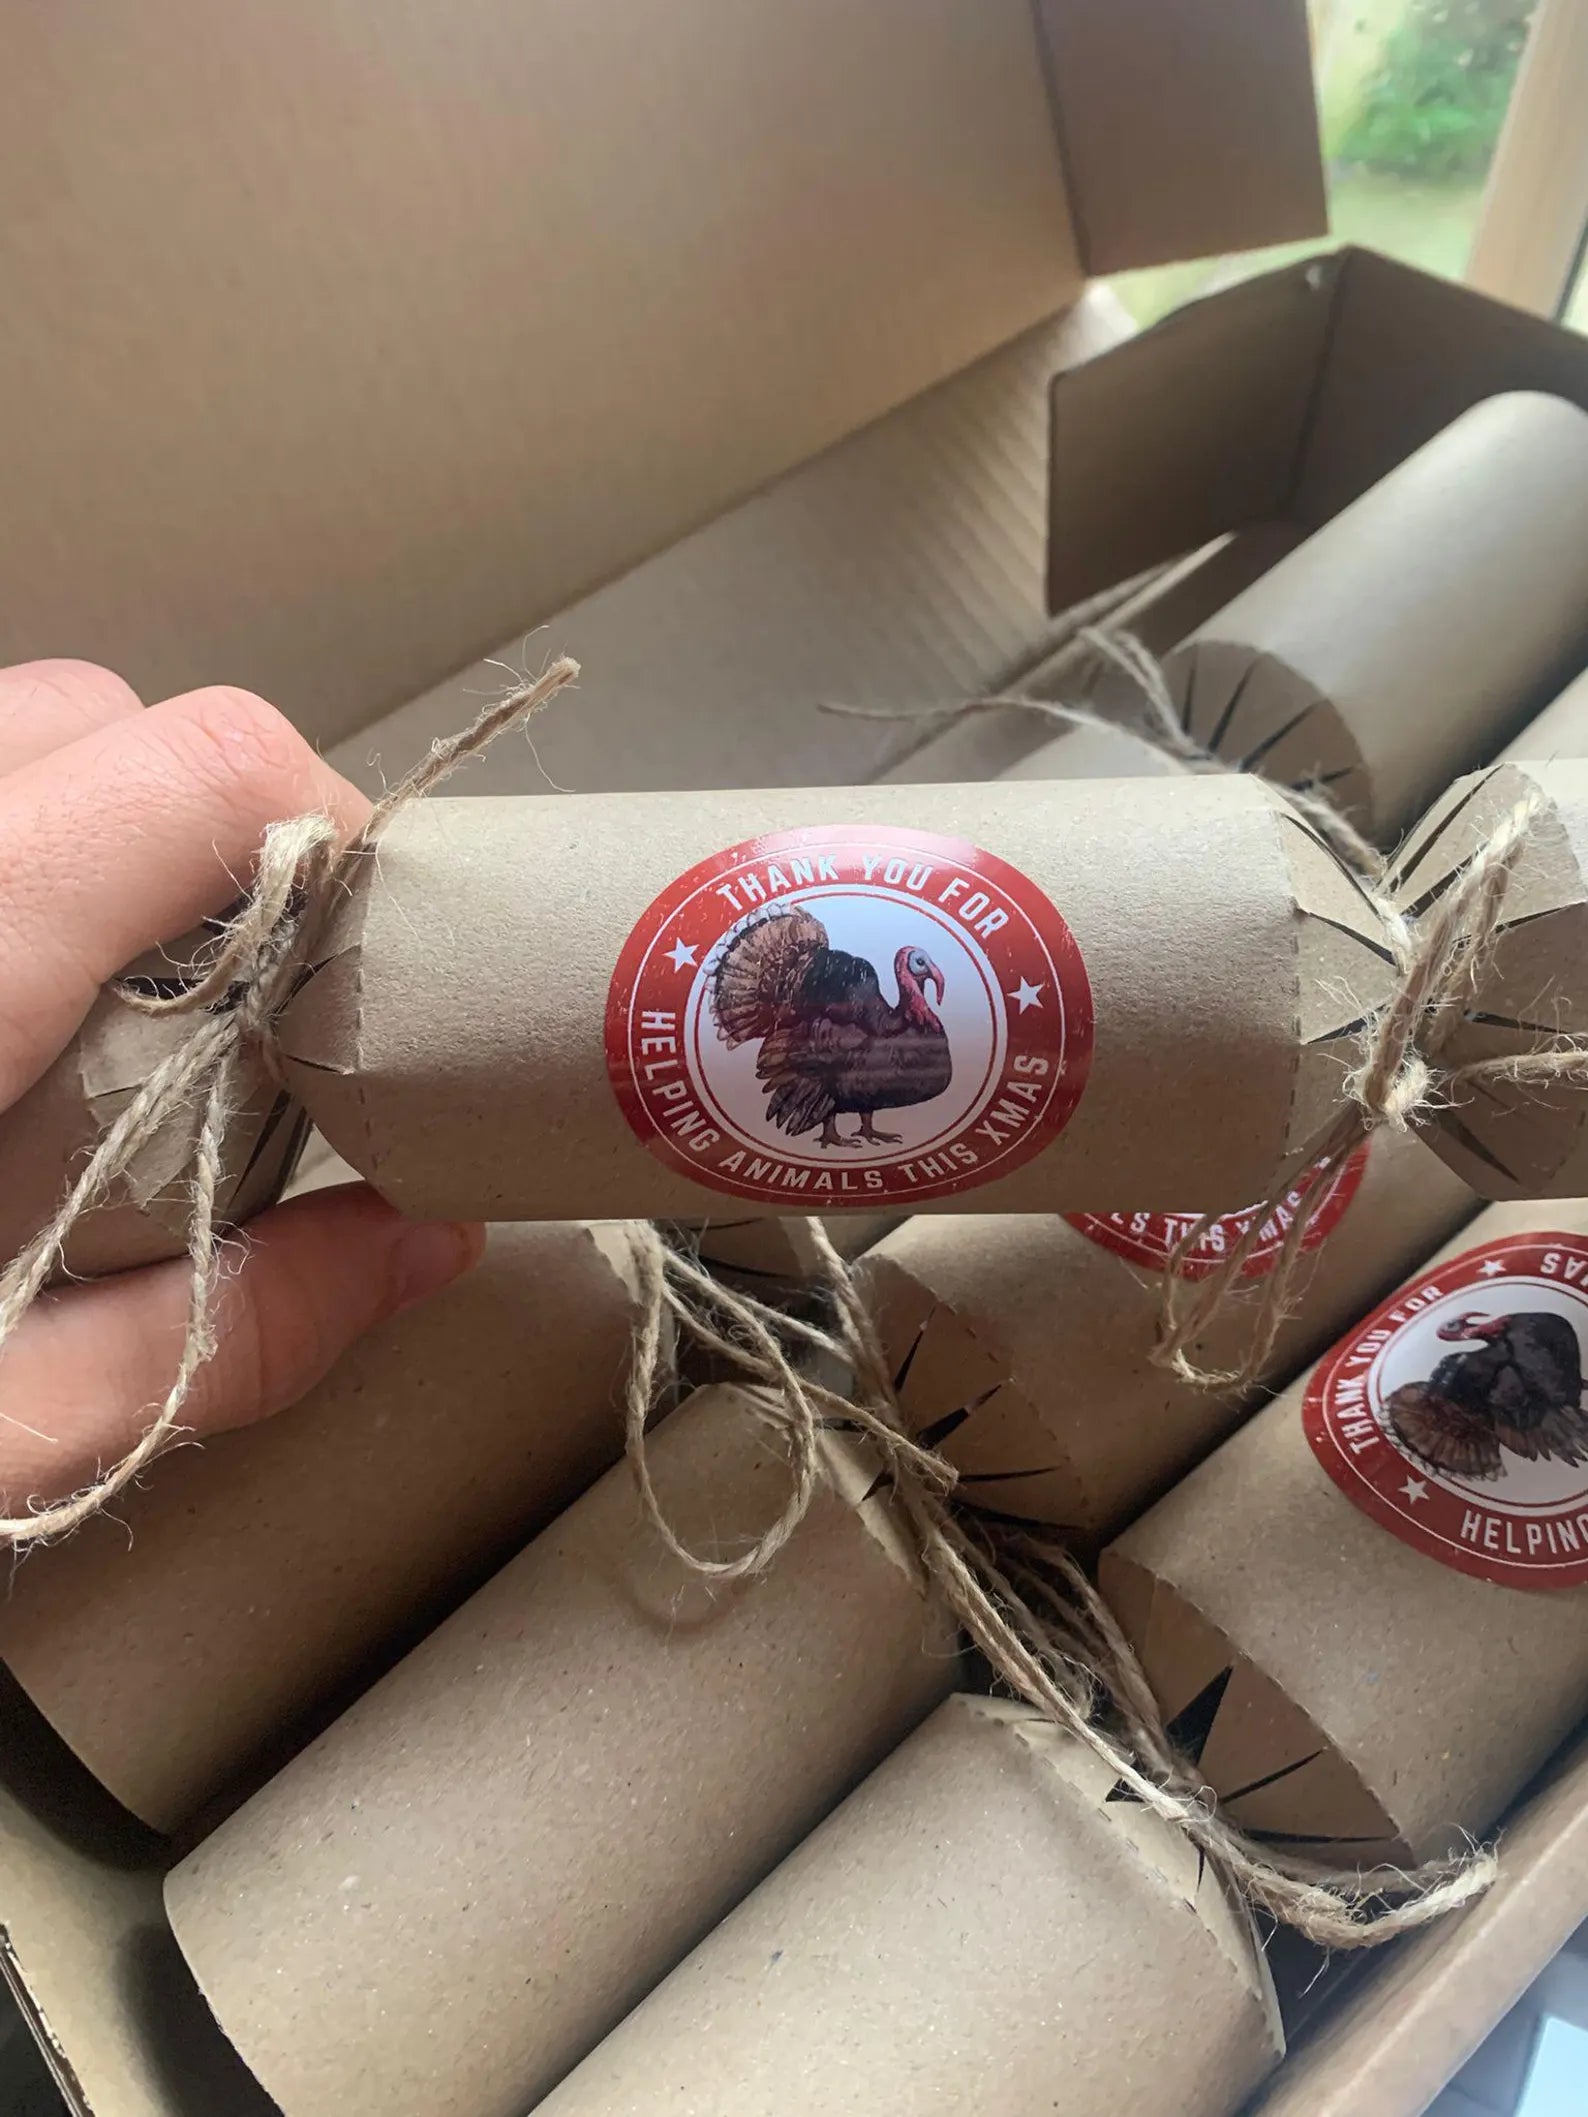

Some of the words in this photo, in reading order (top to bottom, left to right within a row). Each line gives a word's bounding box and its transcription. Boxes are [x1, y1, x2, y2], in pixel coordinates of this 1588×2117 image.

[715, 853, 839, 912] THANK
[862, 855, 933, 892] YOU
[938, 877, 1009, 940] FOR
[640, 1010, 721, 1152] HELPING
[718, 1150, 883, 1191] ANIMALS
[897, 1143, 979, 1183] THIS
[975, 1055, 1049, 1146] XMAS
[1388, 1285, 1444, 1322] FOR
[1345, 1329, 1392, 1367] YOU
[1335, 1374, 1380, 1455] THANK
